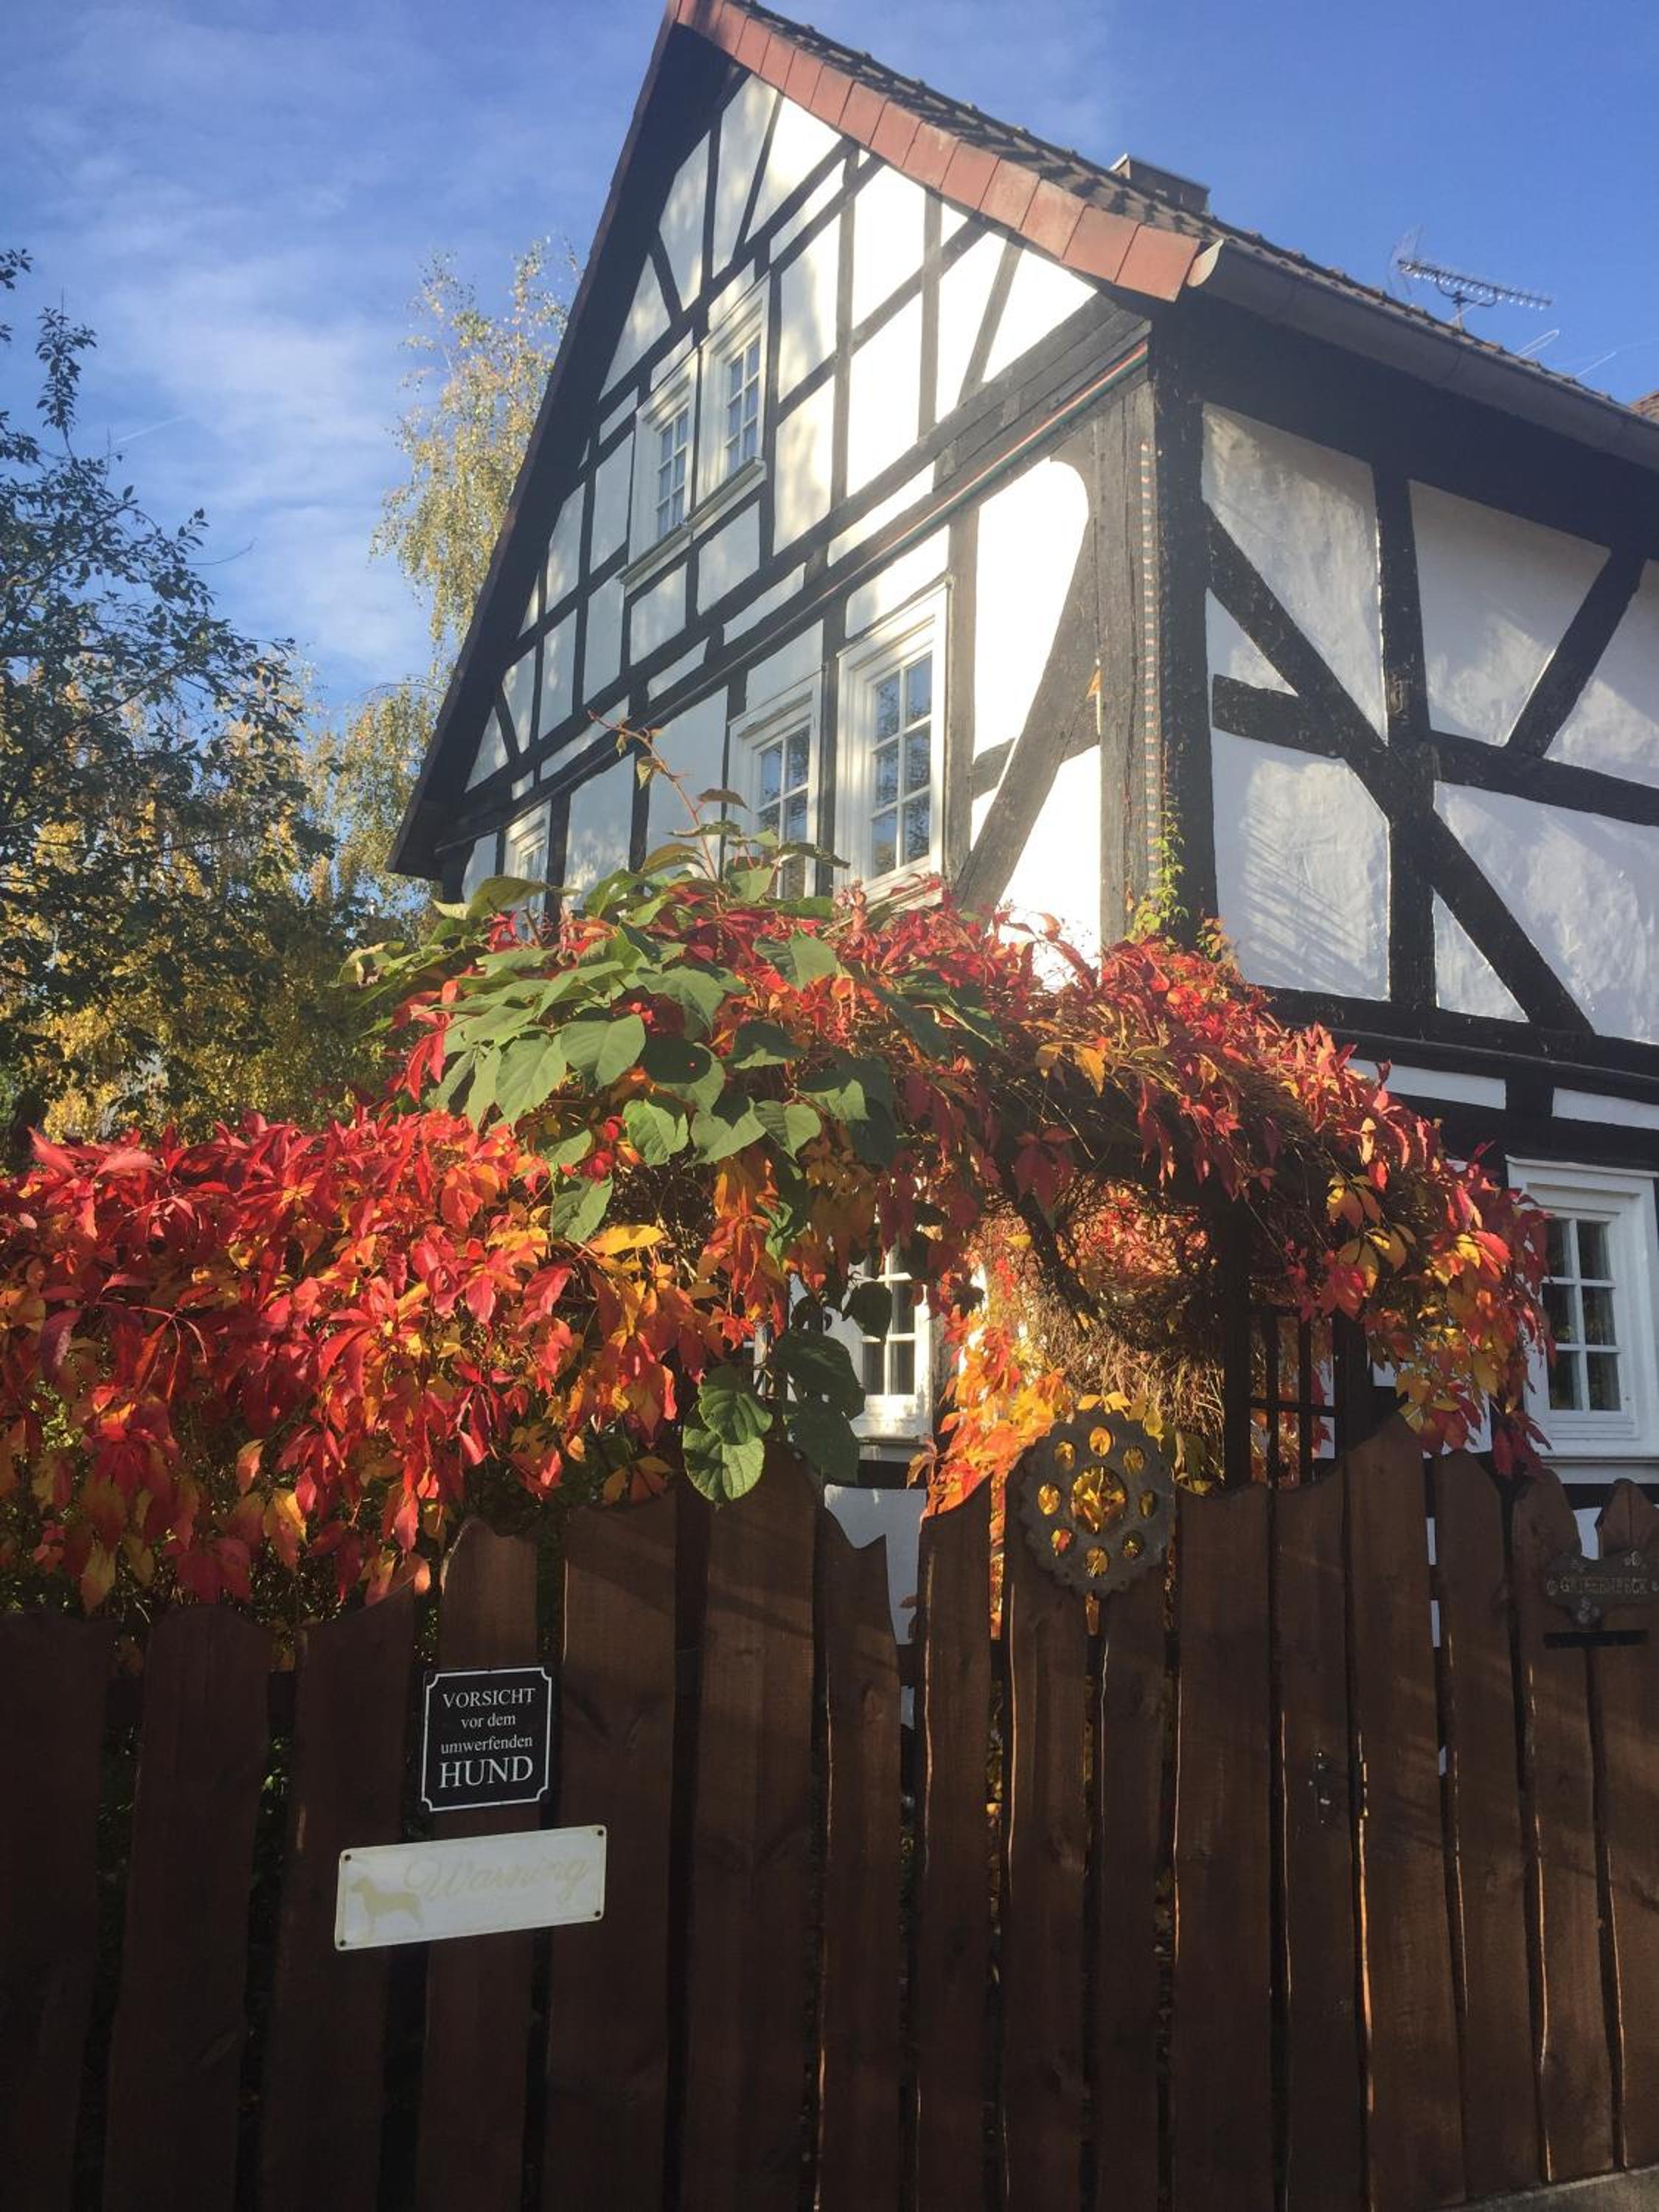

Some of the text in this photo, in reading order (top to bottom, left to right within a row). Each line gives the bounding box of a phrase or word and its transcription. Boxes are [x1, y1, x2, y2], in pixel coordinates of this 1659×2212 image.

[442, 1688, 536, 1708] VORSICHT
[462, 1713, 516, 1729] vor dem
[441, 1734, 533, 1754] umwerfenden
[439, 1756, 534, 1789] HUND
